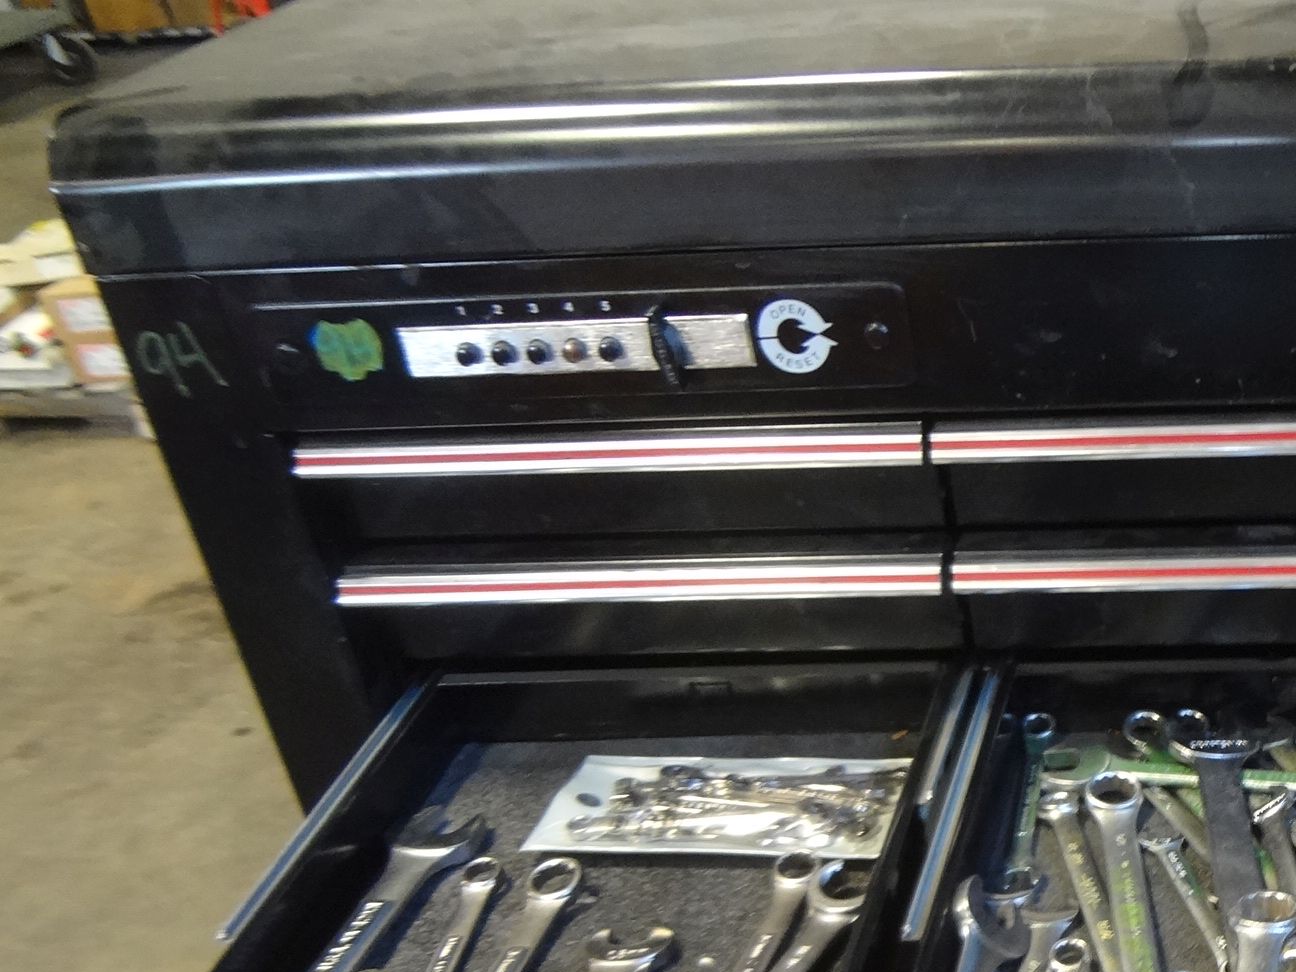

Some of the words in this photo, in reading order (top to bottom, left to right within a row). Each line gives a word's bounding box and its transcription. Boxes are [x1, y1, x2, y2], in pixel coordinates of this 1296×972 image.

[491, 304, 504, 316] 2
[527, 302, 540, 315] 3
[563, 301, 575, 313] 4
[600, 300, 612, 312] 5
[770, 303, 807, 320] OPEN
[775, 351, 821, 369] RESET
